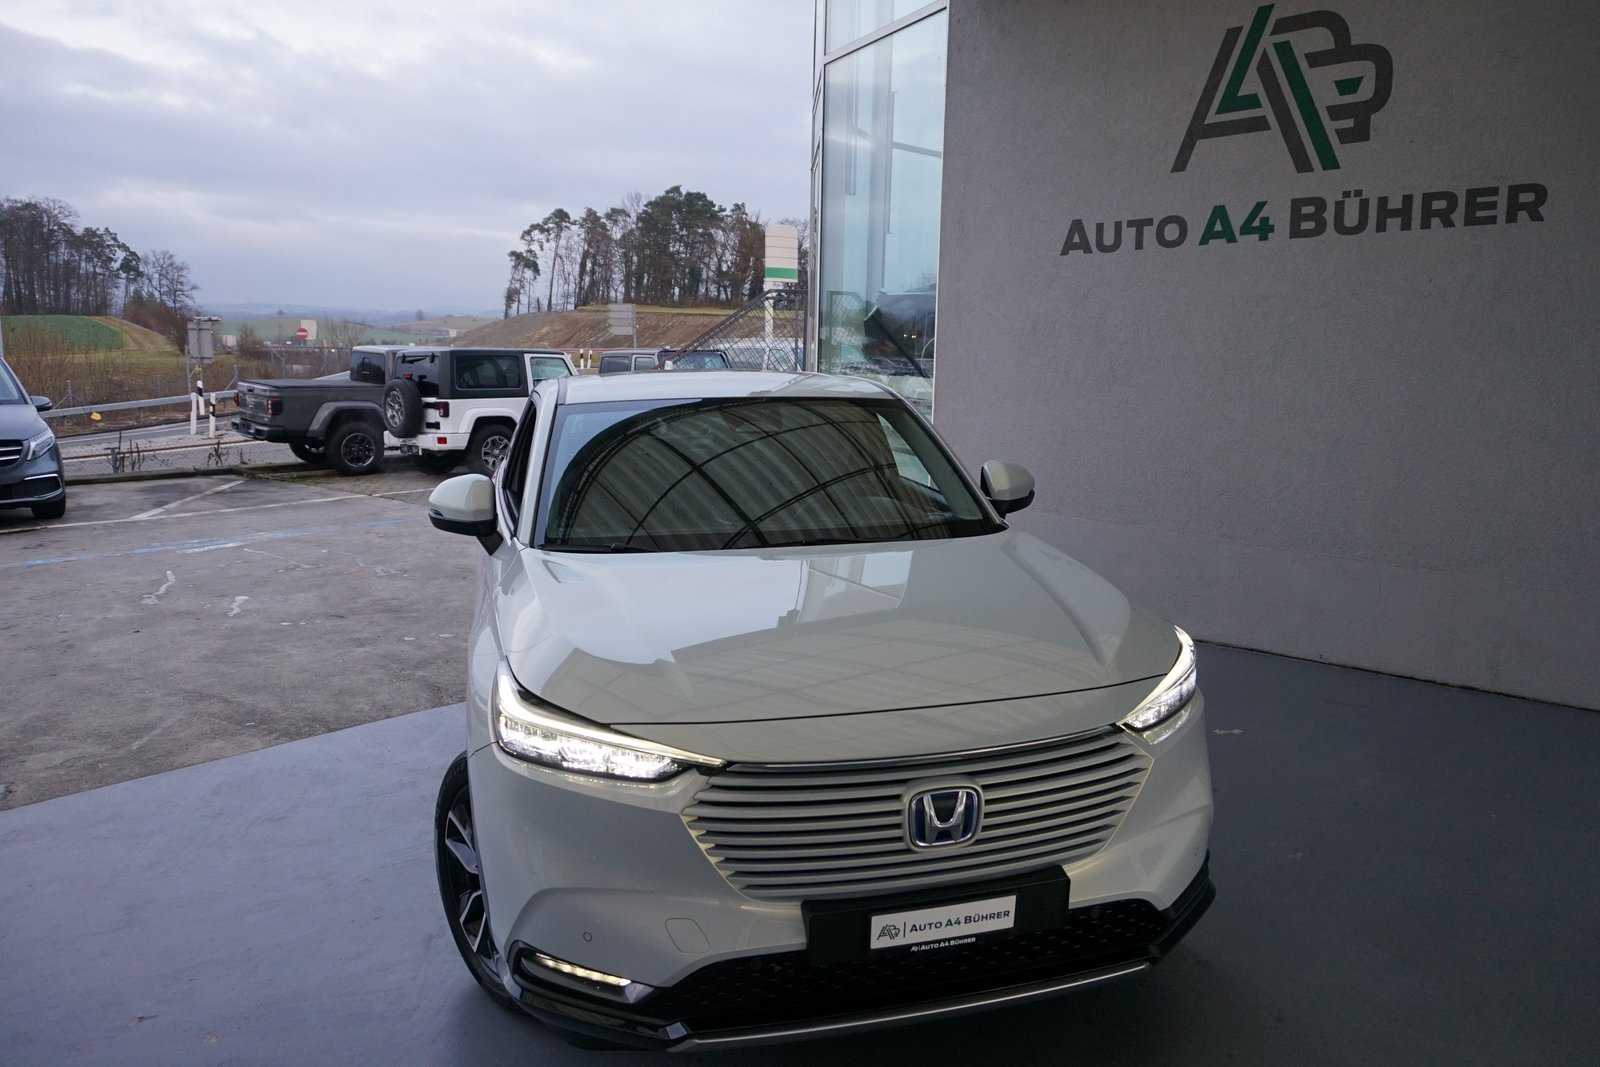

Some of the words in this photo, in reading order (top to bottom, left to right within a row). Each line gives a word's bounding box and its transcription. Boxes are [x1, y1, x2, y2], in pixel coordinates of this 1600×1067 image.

[1060, 215, 1188, 256] AUTO
[1198, 201, 1275, 246] A4
[1288, 183, 1549, 239] BÜHRER
[909, 921, 942, 933] AUTO
[945, 917, 961, 927] A4
[965, 910, 1010, 924] BÜHRER
[920, 943, 939, 951] AUTO
[949, 937, 976, 946] BÜHRER
